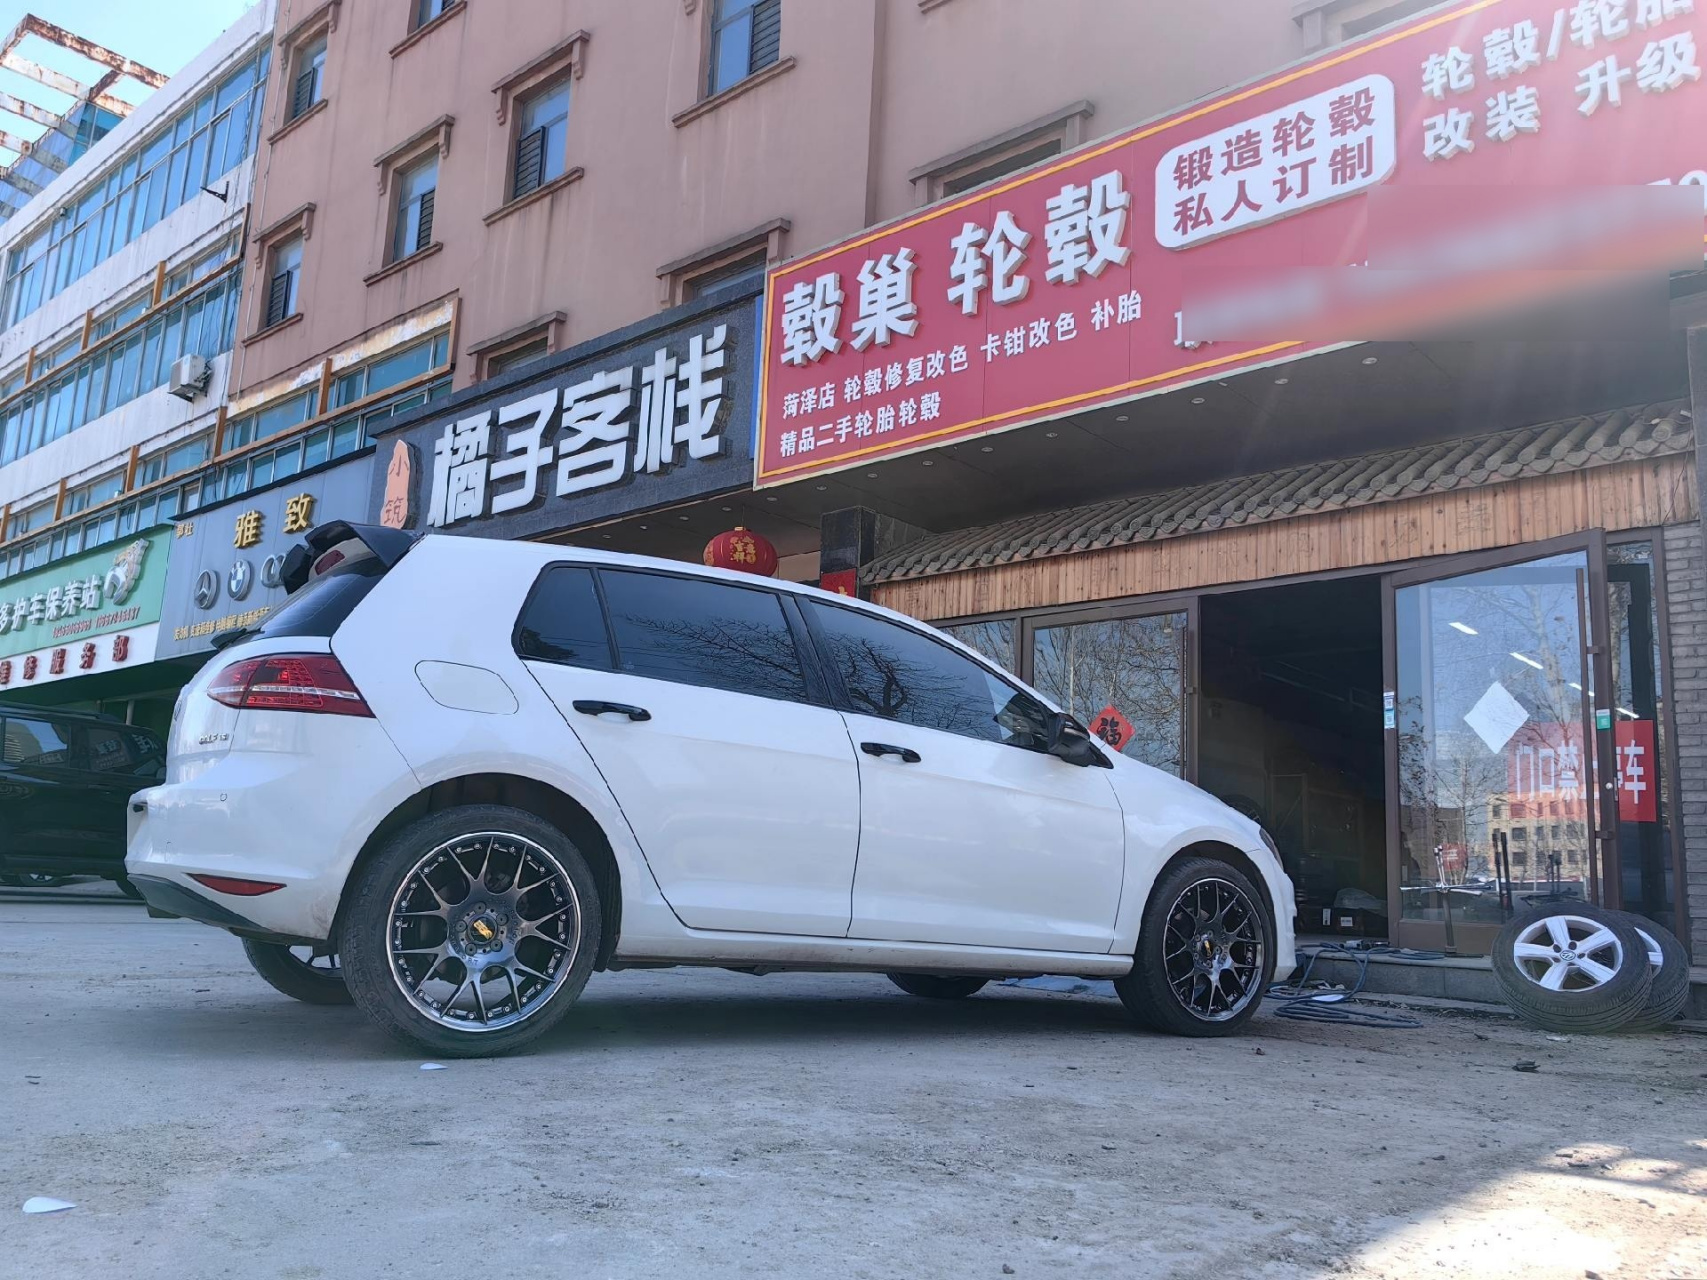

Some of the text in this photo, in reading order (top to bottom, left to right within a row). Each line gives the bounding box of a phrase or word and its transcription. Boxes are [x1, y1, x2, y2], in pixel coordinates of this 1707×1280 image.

[1172, 86, 1376, 192] 锻造轮毂
[1422, 31, 1702, 162] 改装 升级
[1172, 137, 1375, 237] 私人订制
[781, 381, 836, 420] 菏泽店
[843, 344, 969, 404] 轮毂修复改色
[980, 312, 1078, 363] 卡钳改色
[1090, 290, 1142, 331] 补胎
[427, 323, 736, 528] 橘子客栈
[780, 391, 942, 458] 精品二手轮胎轮毂
[233, 493, 314, 549] 雅致
